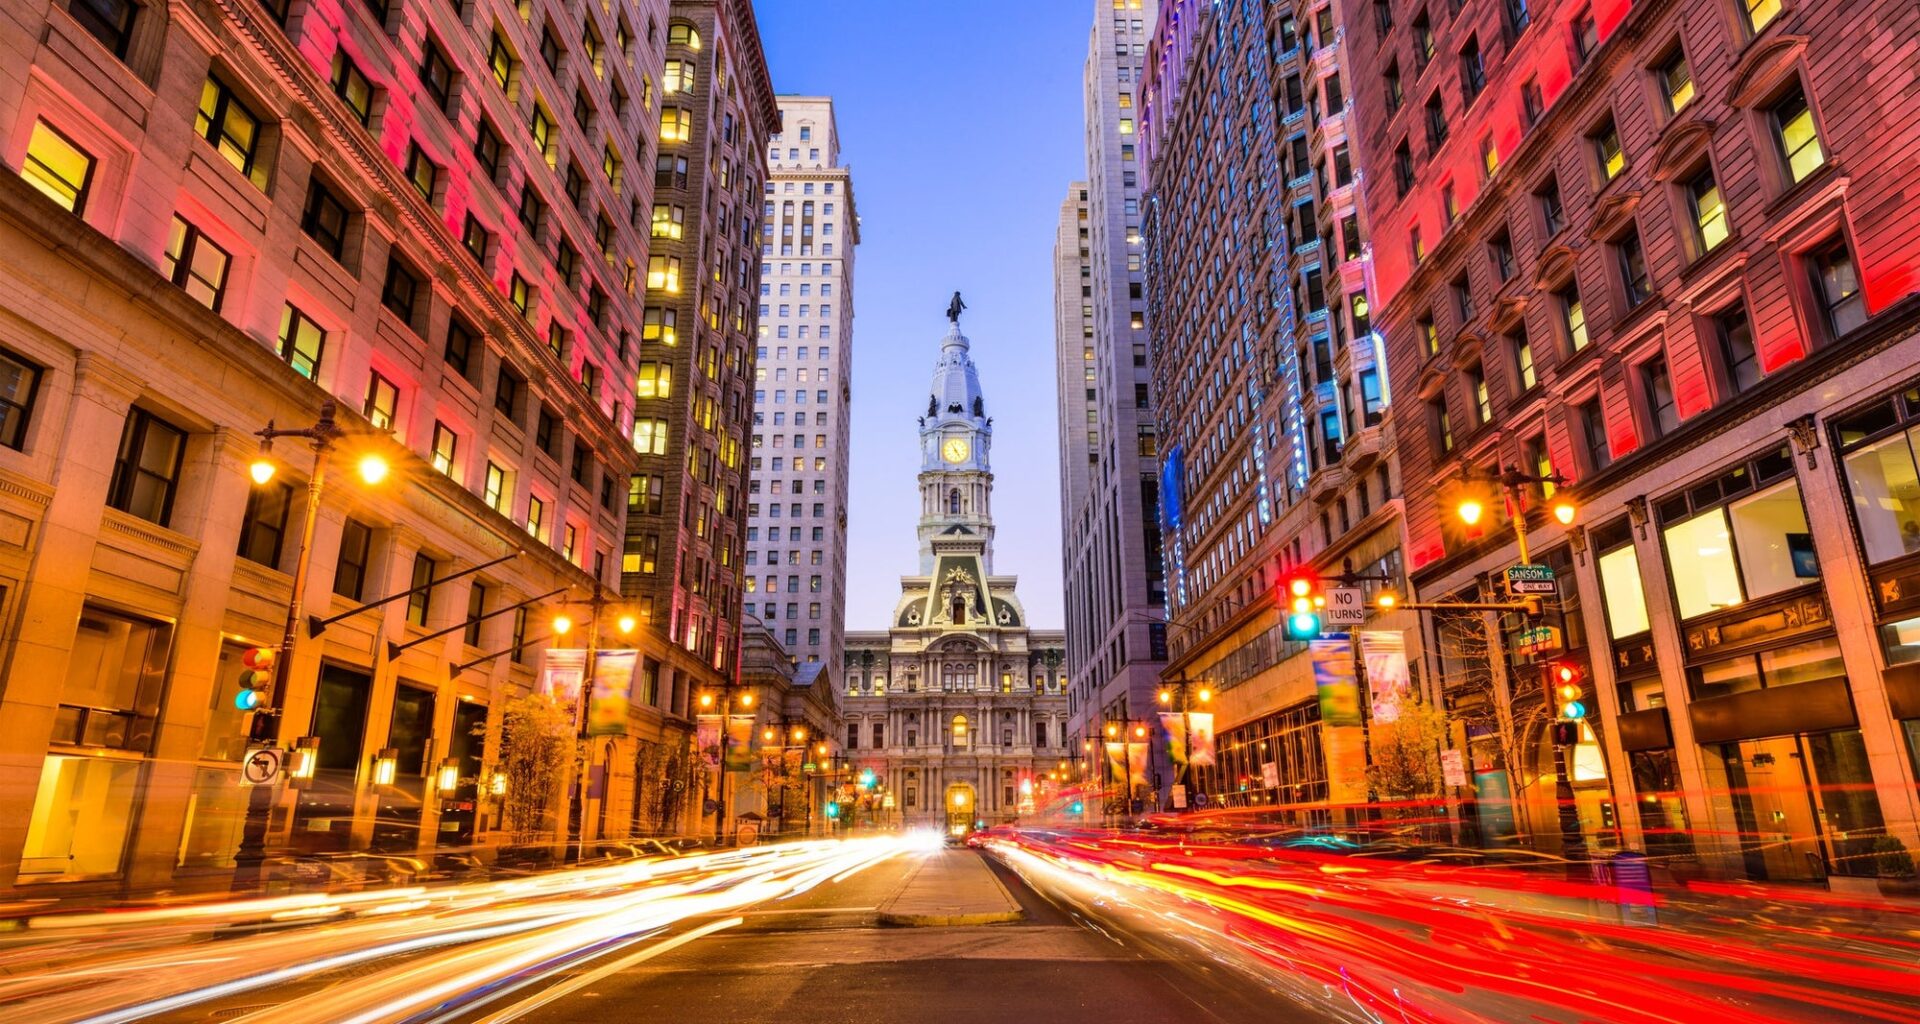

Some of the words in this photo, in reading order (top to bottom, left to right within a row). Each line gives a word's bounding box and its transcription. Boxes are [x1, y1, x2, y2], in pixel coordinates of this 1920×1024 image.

[1509, 570, 1544, 579] SANSOM
[1335, 592, 1353, 604] NO
[1329, 609, 1362, 619] TURNS
